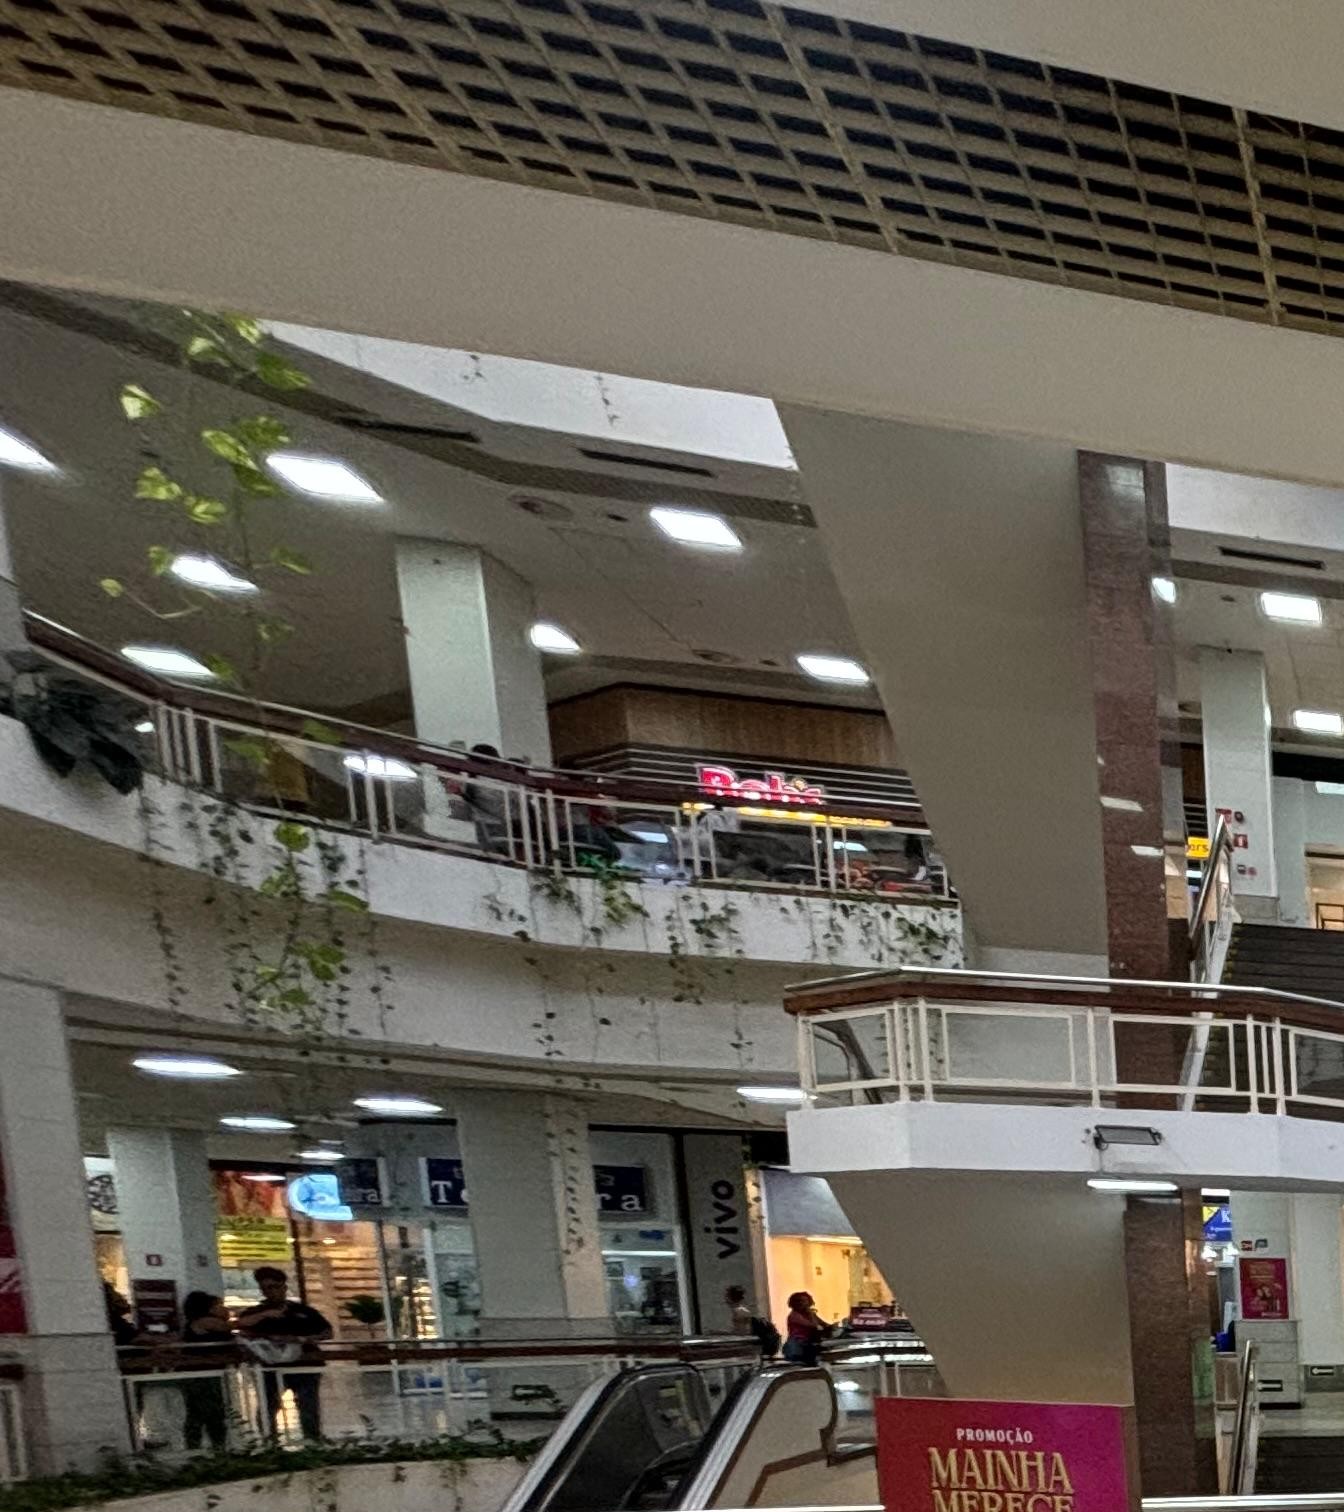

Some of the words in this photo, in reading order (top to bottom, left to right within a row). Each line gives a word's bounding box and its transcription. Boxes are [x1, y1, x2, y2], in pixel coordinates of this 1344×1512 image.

[704, 1179, 740, 1260] vivo
[955, 1427, 1034, 1445] PROMOÇÃO
[928, 1447, 1075, 1495] MAINHA
